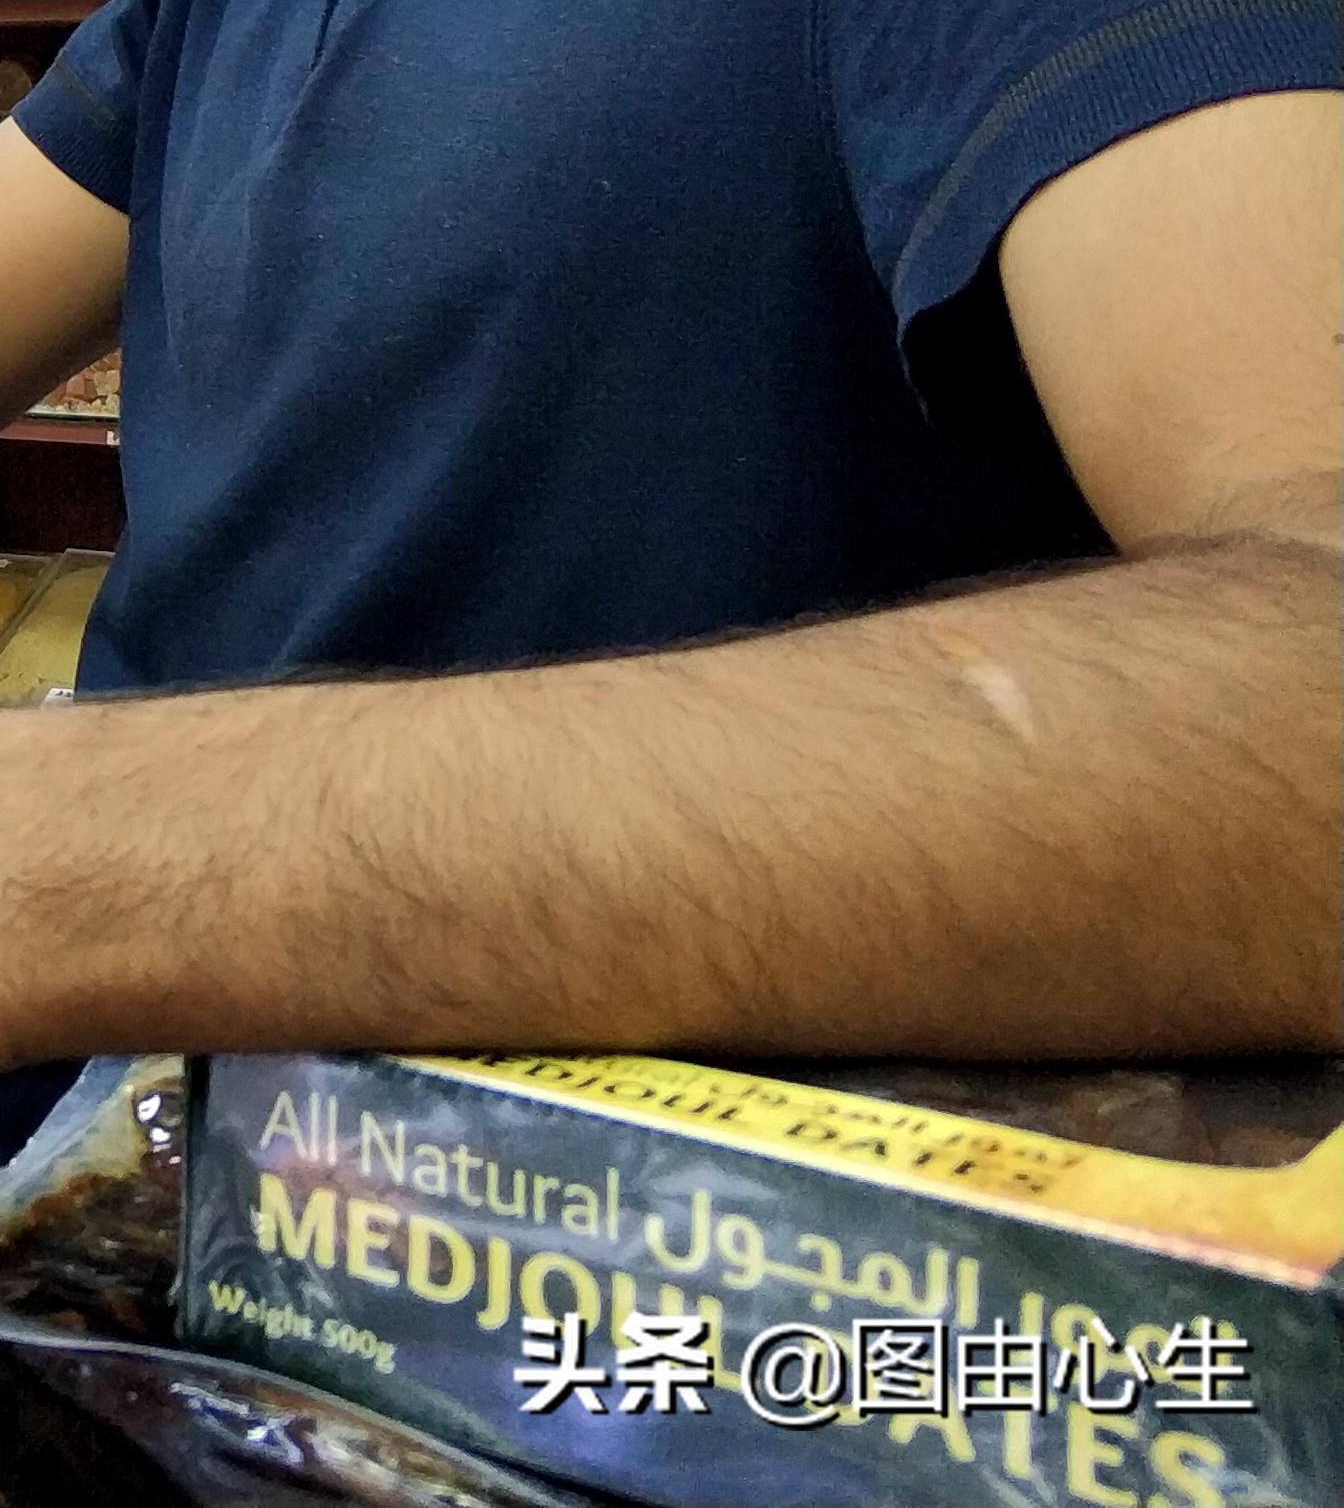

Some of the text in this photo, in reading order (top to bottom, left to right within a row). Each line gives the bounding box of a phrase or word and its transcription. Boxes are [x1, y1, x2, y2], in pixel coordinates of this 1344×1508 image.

[259, 1090, 338, 1168] All
[360, 1108, 620, 1242] Natural
[643, 1187, 980, 1330] المجول
